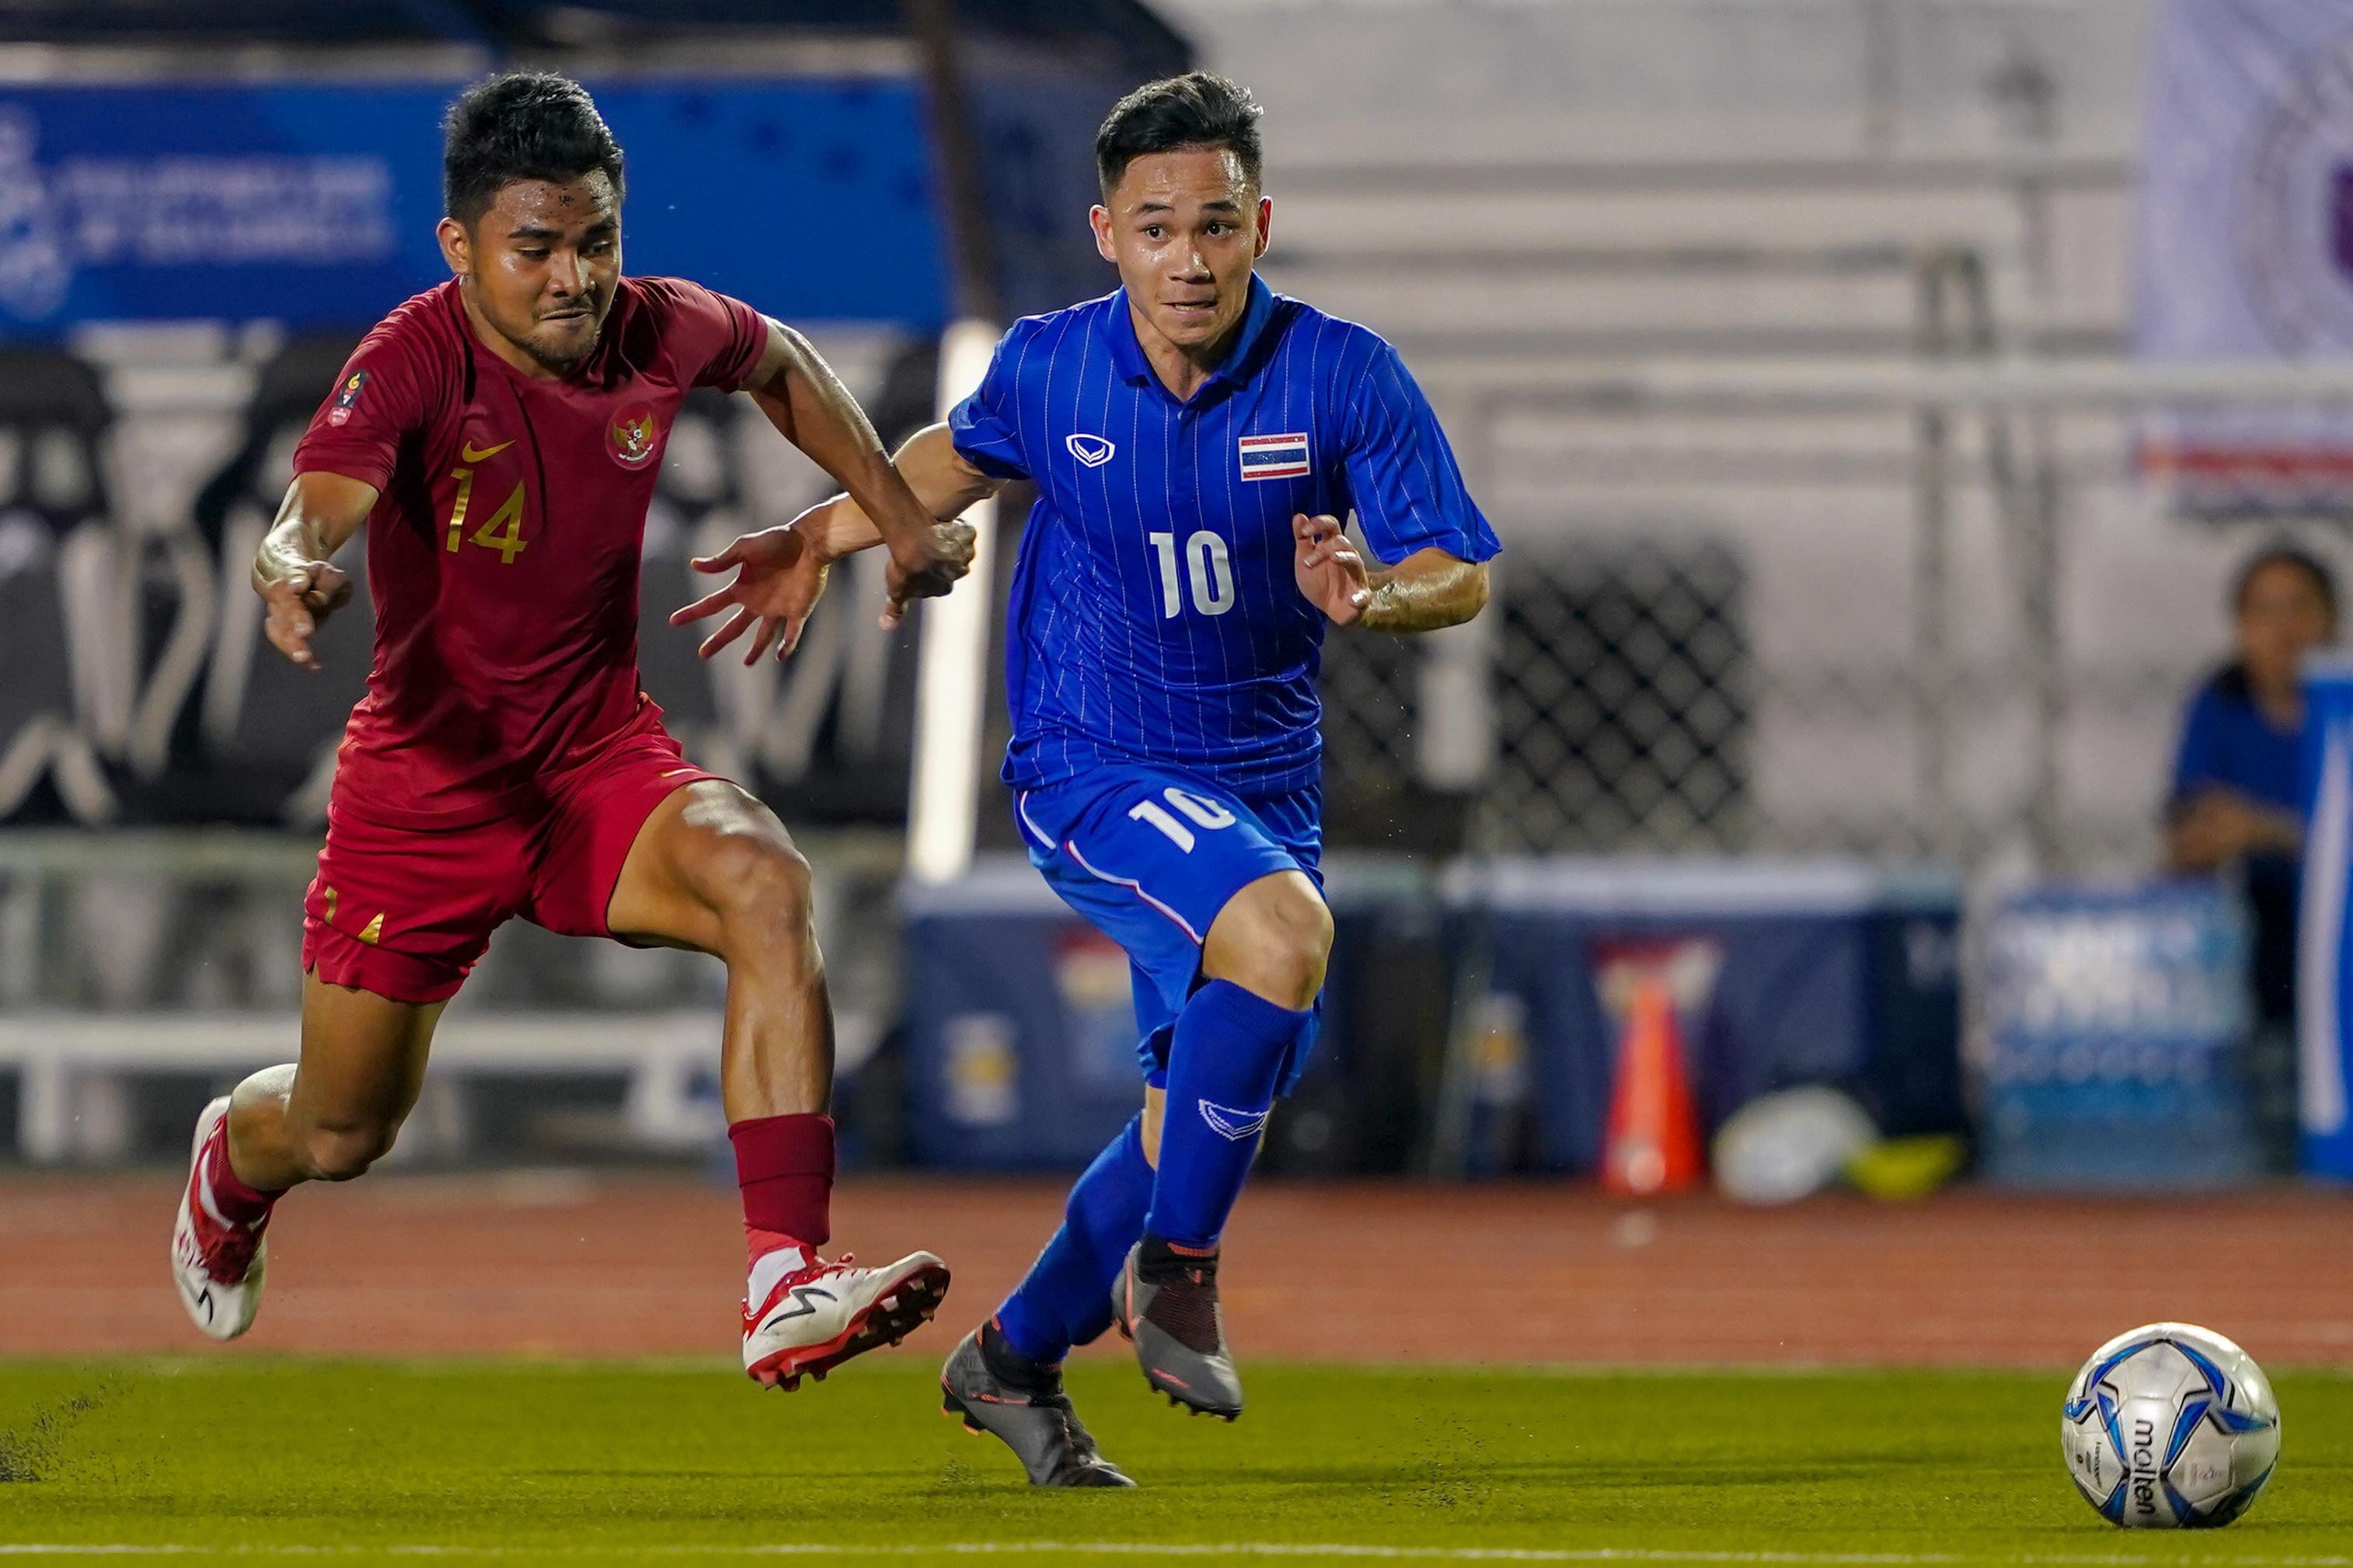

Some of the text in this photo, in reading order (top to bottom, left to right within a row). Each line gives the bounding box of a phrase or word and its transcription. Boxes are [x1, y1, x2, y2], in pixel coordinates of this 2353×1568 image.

[446, 468, 528, 564] 14
[1149, 530, 1236, 618] 10
[1128, 788, 1236, 854] 10
[2134, 1419, 2157, 1514] molten
